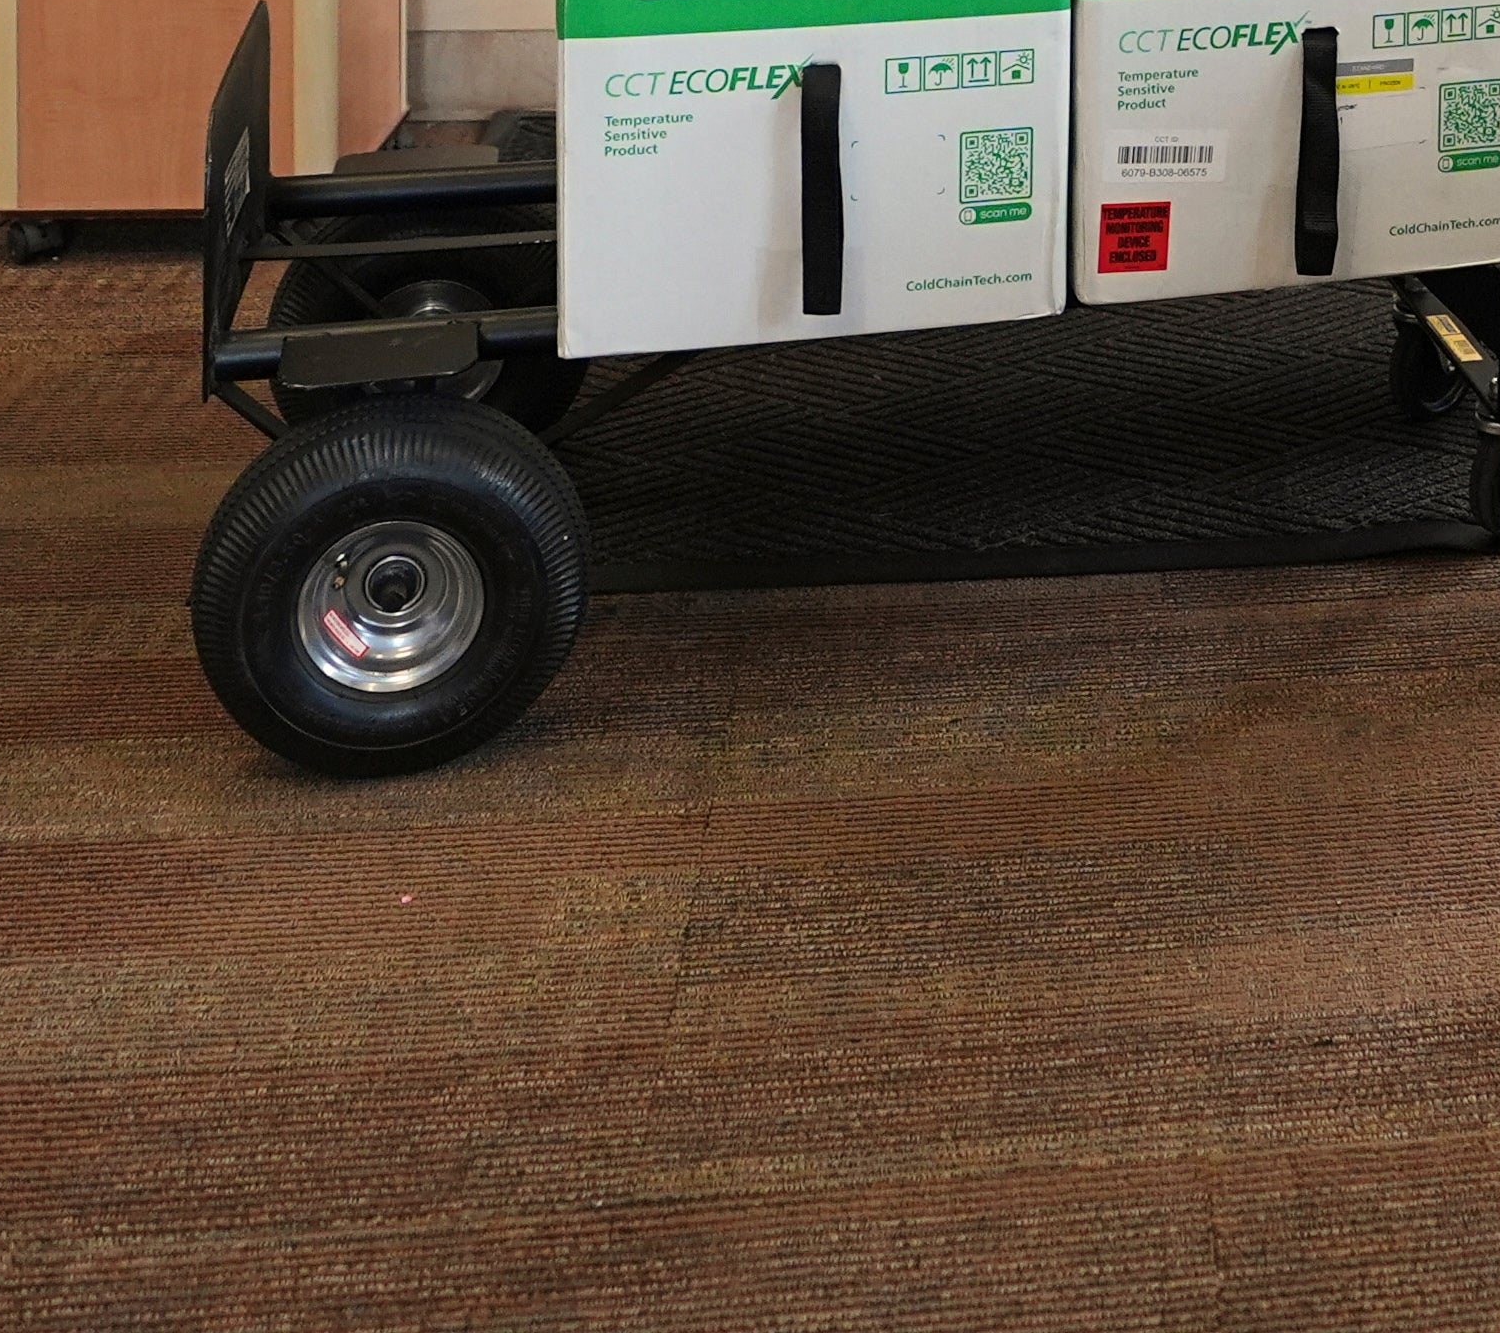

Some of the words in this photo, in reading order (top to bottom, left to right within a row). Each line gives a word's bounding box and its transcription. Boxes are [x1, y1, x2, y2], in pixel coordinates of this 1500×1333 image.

[1118, 28, 1175, 54] CCT
[1176, 13, 1308, 55] ECOFLEX
[604, 72, 666, 98] CCT
[669, 55, 812, 100] ECOFLEX
[1117, 67, 1199, 83] Temperature
[1117, 83, 1175, 97] Sensitive
[1117, 98, 1167, 112] Product
[1121, 167, 1208, 179] 6079-B308-06575
[905, 270, 1033, 293] ColdChainTech.com
